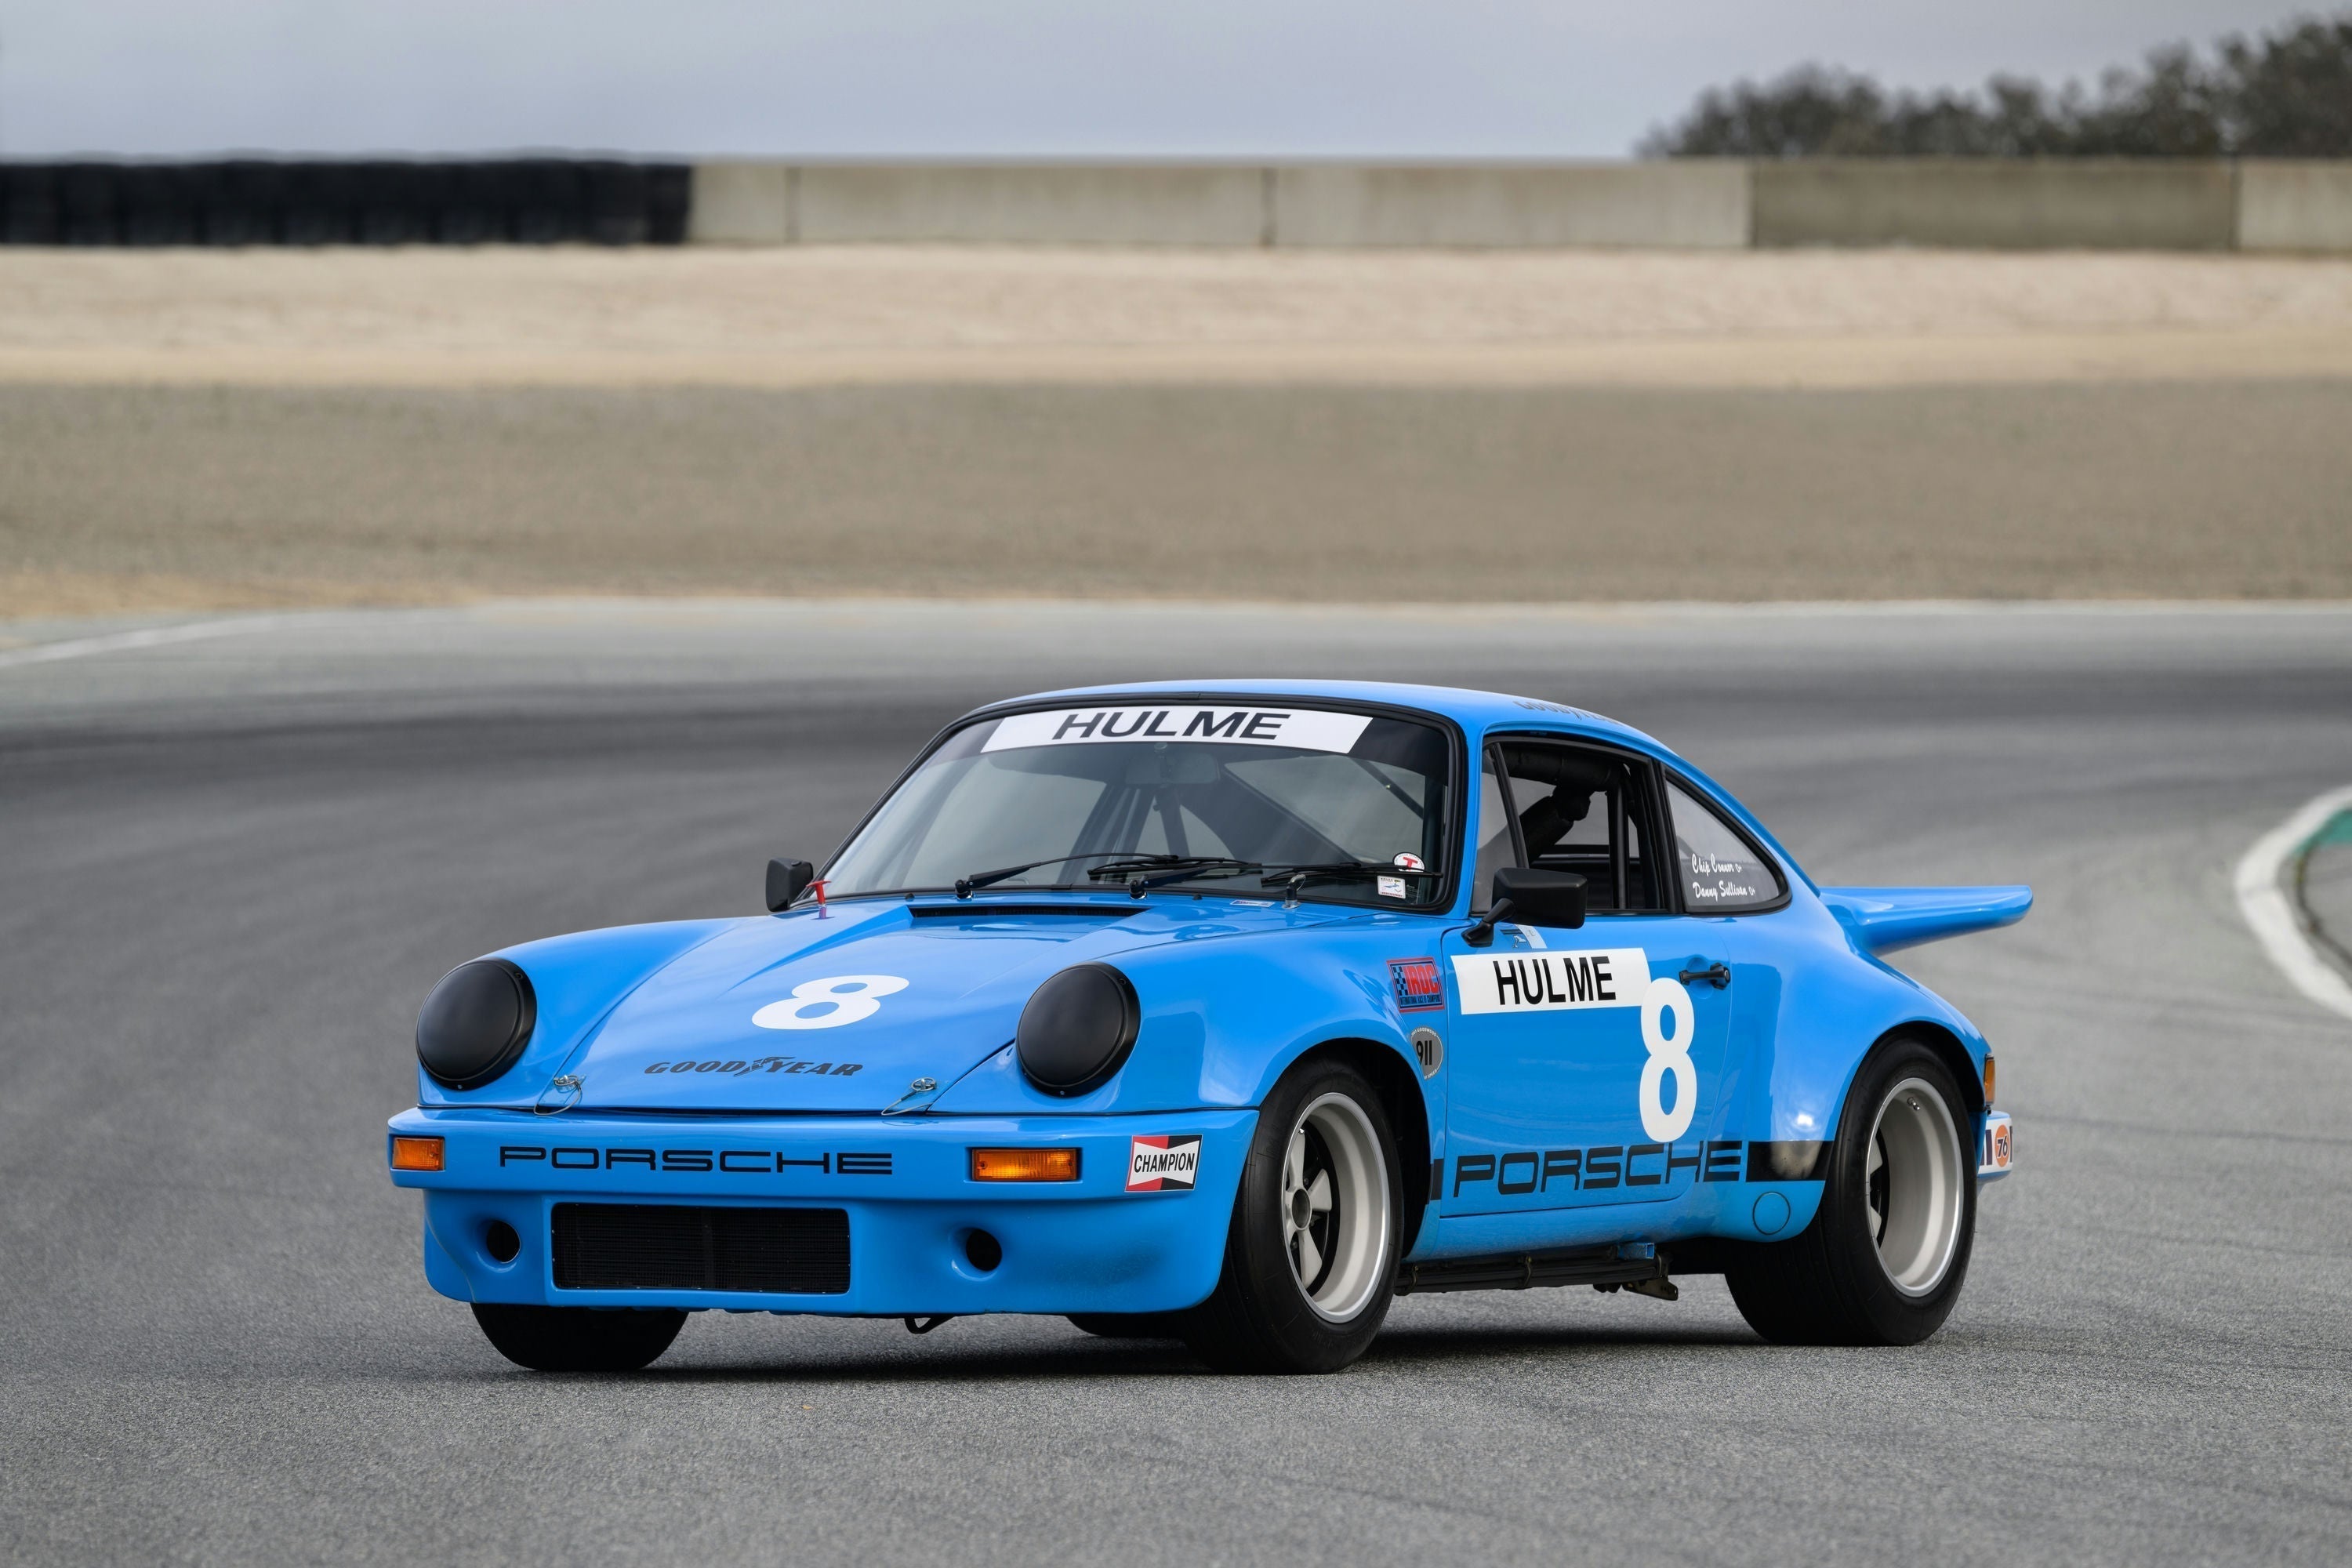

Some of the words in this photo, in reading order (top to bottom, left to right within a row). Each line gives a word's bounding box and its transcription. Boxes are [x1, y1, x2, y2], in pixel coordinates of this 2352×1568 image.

[1052, 710, 1290, 741] HULME
[1692, 853, 1711, 877] Chip
[1693, 881, 1718, 902] Danny
[1719, 880, 1748, 897] Sullivan
[1402, 964, 1439, 996] IROC
[1493, 956, 1616, 1006] HULME
[752, 975, 909, 1030] 8
[1416, 1040, 1432, 1065] 911
[1639, 978, 1697, 1142] 8
[499, 1145, 893, 1175] PORSCHE
[1997, 1135, 2009, 1159] 76
[1134, 1152, 1195, 1173] CHAMPION
[1454, 1141, 1743, 1198] PORSCHE
